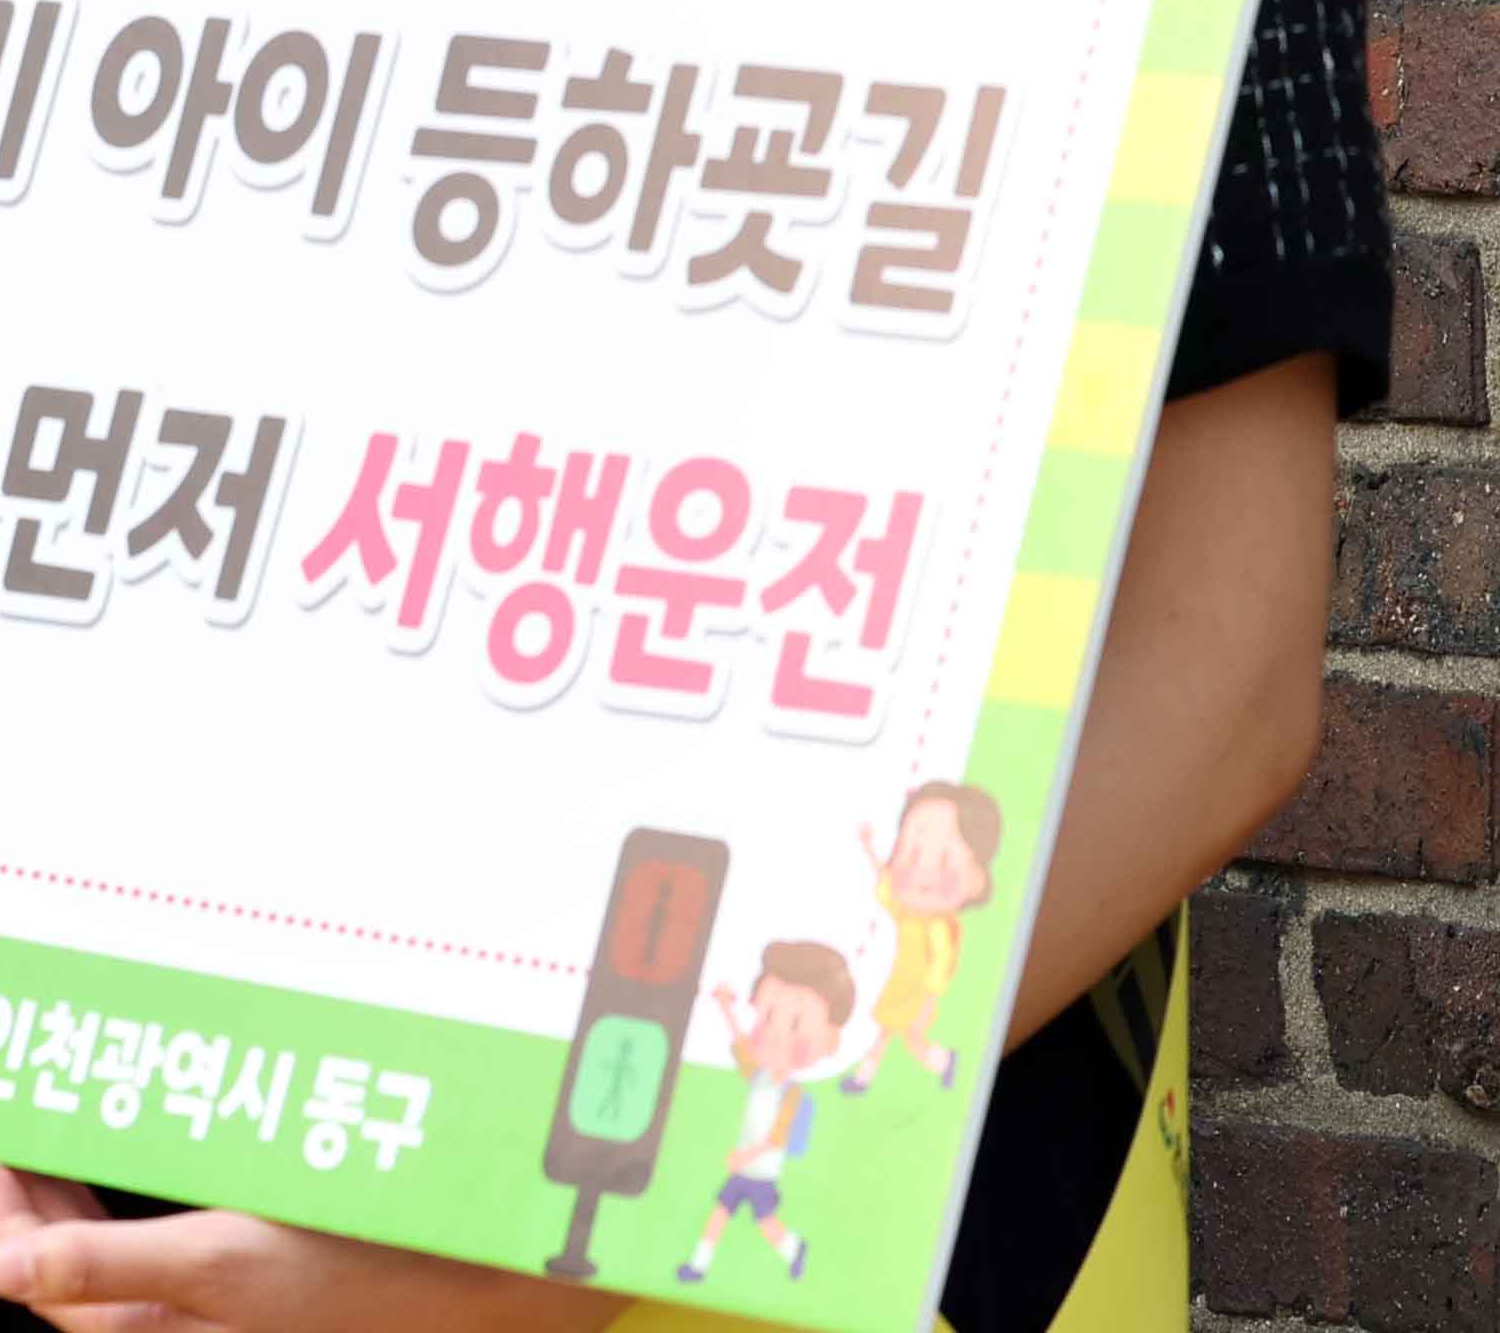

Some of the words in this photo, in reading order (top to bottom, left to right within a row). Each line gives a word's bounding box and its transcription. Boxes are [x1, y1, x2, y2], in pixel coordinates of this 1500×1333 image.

[89, 14, 383, 217] 아이
[408, 32, 1008, 315] 등하굣길
[1, 383, 288, 603] 먼저
[300, 429, 926, 719] 서행운전
[302, 1054, 433, 1173] 동구
